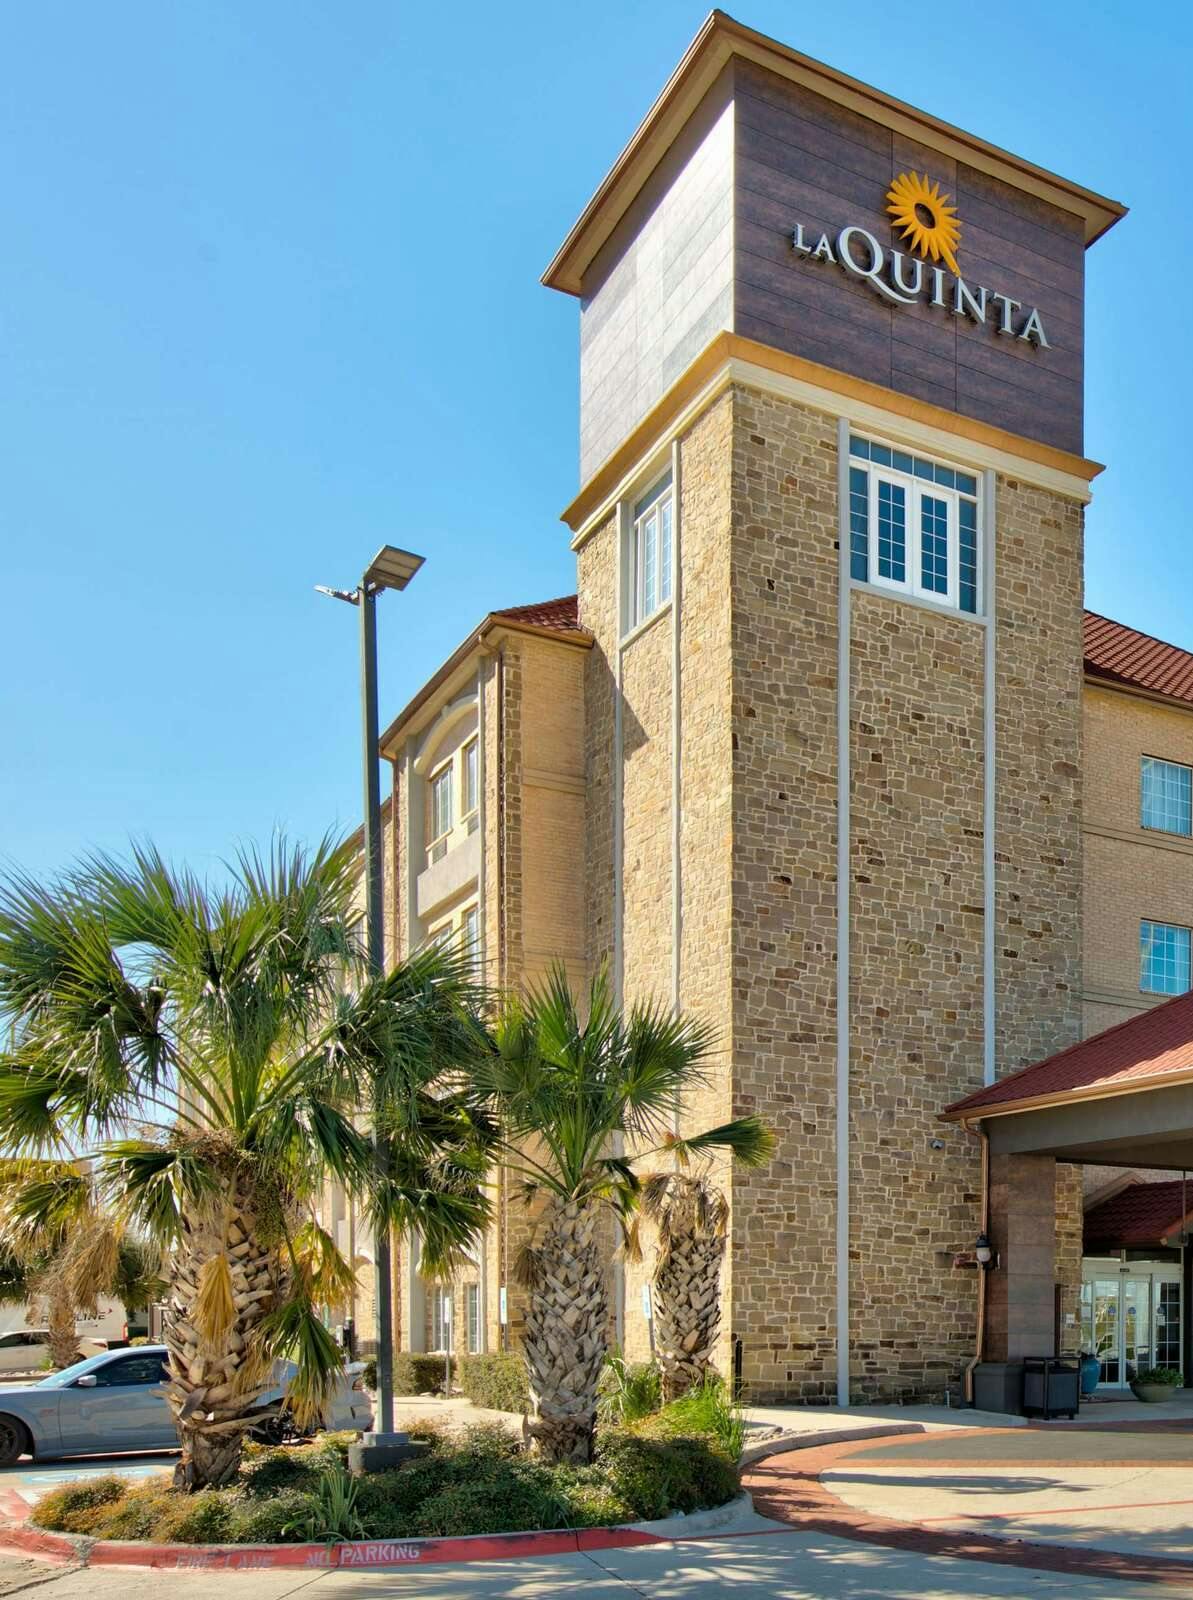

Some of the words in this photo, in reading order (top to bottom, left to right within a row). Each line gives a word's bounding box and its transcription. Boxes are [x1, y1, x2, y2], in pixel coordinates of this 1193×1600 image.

[793, 223, 838, 264] LA
[838, 226, 1052, 349] QUINTA
[340, 1544, 420, 1567] PARKING
